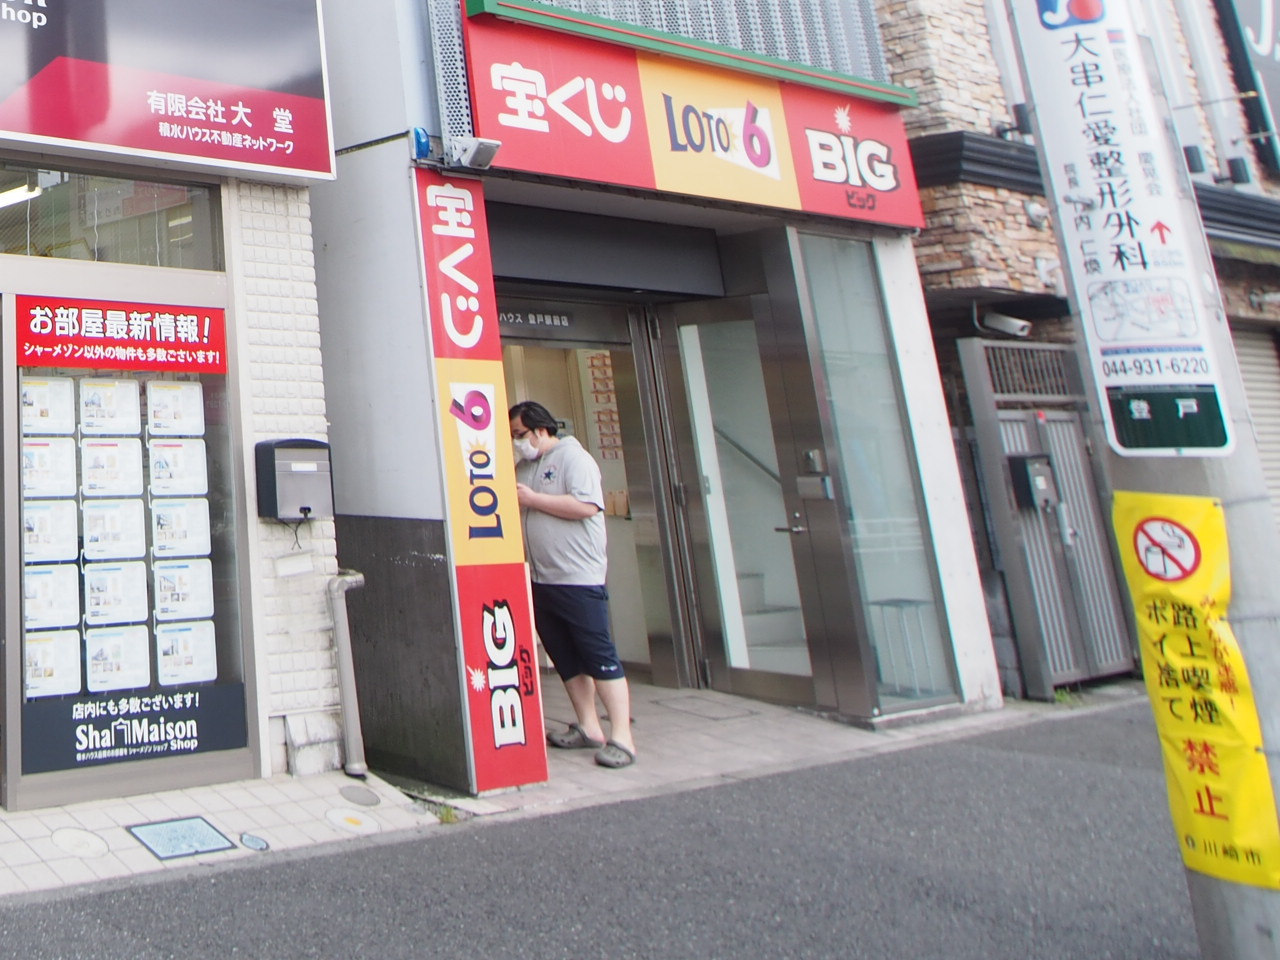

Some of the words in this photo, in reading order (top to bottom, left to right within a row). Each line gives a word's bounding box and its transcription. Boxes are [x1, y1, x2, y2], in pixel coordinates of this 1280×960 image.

[158, 121, 294, 155] 積水ハウス不動産ネットワーク
[490, 62, 632, 143] 宝くじ
[805, 127, 898, 192] BIG
[1061, 32, 1149, 272] 大串仁愛整形外科
[845, 189, 877, 211] ビッグ
[426, 183, 483, 348] 宝くじ
[1102, 358, 1208, 377] 044-931-6220
[483, 599, 526, 748] BIG
[1171, 601, 1222, 726] 路上喫煙
[170, 739, 198, 751] Shop
[1182, 738, 1230, 822] 禁止
